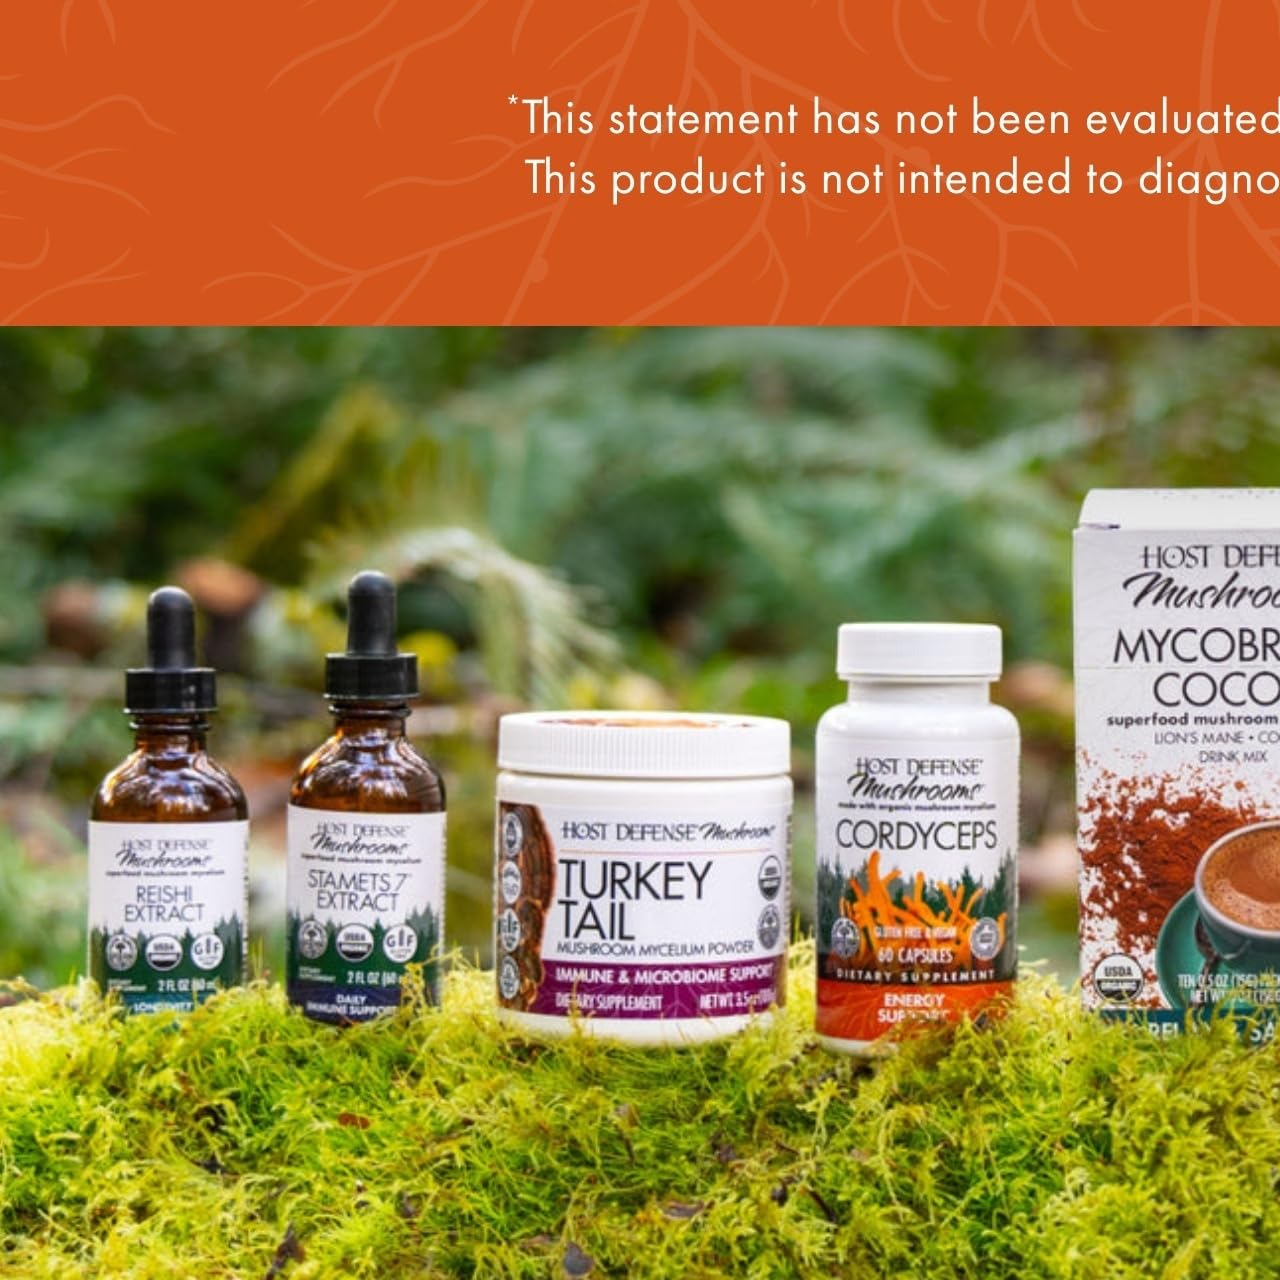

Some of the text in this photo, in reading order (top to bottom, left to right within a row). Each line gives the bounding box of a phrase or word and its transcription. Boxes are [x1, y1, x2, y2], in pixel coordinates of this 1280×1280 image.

[1140, 545, 1212, 569] HOST
[1107, 712, 1189, 728] superfood
[1194, 711, 1278, 726] mushroom
[1154, 731, 1198, 745] LION'S
[1201, 731, 1245, 745] MANE
[1199, 750, 1268, 763] DRINK MIX
[856, 758, 900, 775] HOST
[847, 773, 983, 800] Mushrooms
[560, 821, 609, 840] HOST
[616, 823, 697, 842] DEFENSE
[836, 819, 998, 850] CORDYCEPS
[308, 869, 390, 891] STAMETS
[559, 858, 713, 901] TURKEY
[136, 885, 193, 903] REISHI
[317, 890, 400, 911] EXTRACT
[125, 903, 205, 922] EXTRACT
[558, 900, 635, 941] TAIL
[556, 940, 754, 957] MUSHROOM MYCELIUM POWDER
[877, 947, 953, 964] 60 CAPSULES
[555, 963, 774, 986] IMMUNE & MICROBIOME SUPPORT
[836, 967, 995, 983] DIETARY SUPPLEMENT
[1104, 966, 1133, 977] USDA
[596, 995, 664, 1012] SUPPLEMENT
[884, 992, 946, 1008] ENERGY
